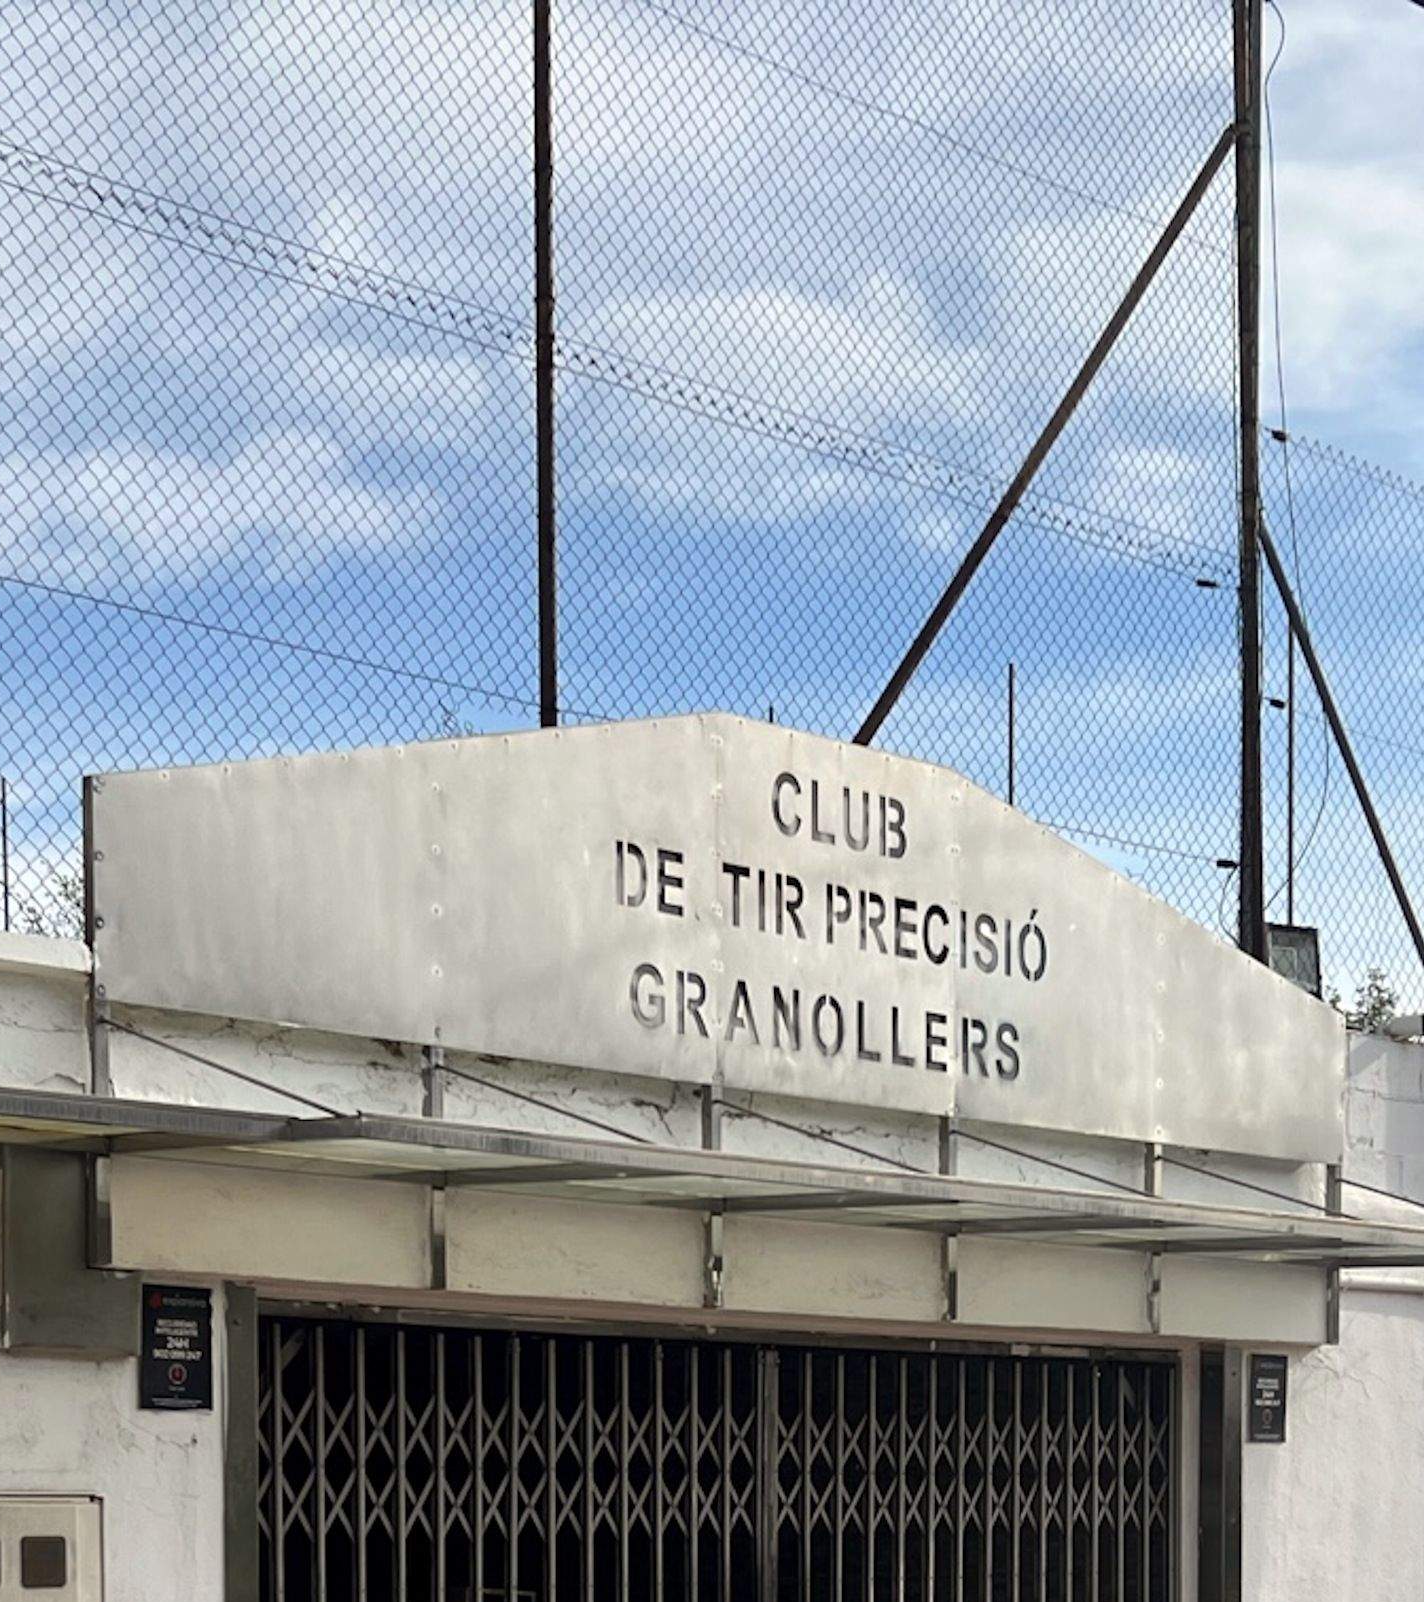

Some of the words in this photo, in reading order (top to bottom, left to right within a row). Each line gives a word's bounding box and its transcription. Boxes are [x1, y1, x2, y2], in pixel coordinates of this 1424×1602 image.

[772, 772, 907, 858] CLUB
[615, 841, 684, 917] DE
[722, 863, 806, 939] TIR
[826, 884, 1048, 982] PRECISIÓ
[630, 964, 1020, 1081] GRANOLLERS
